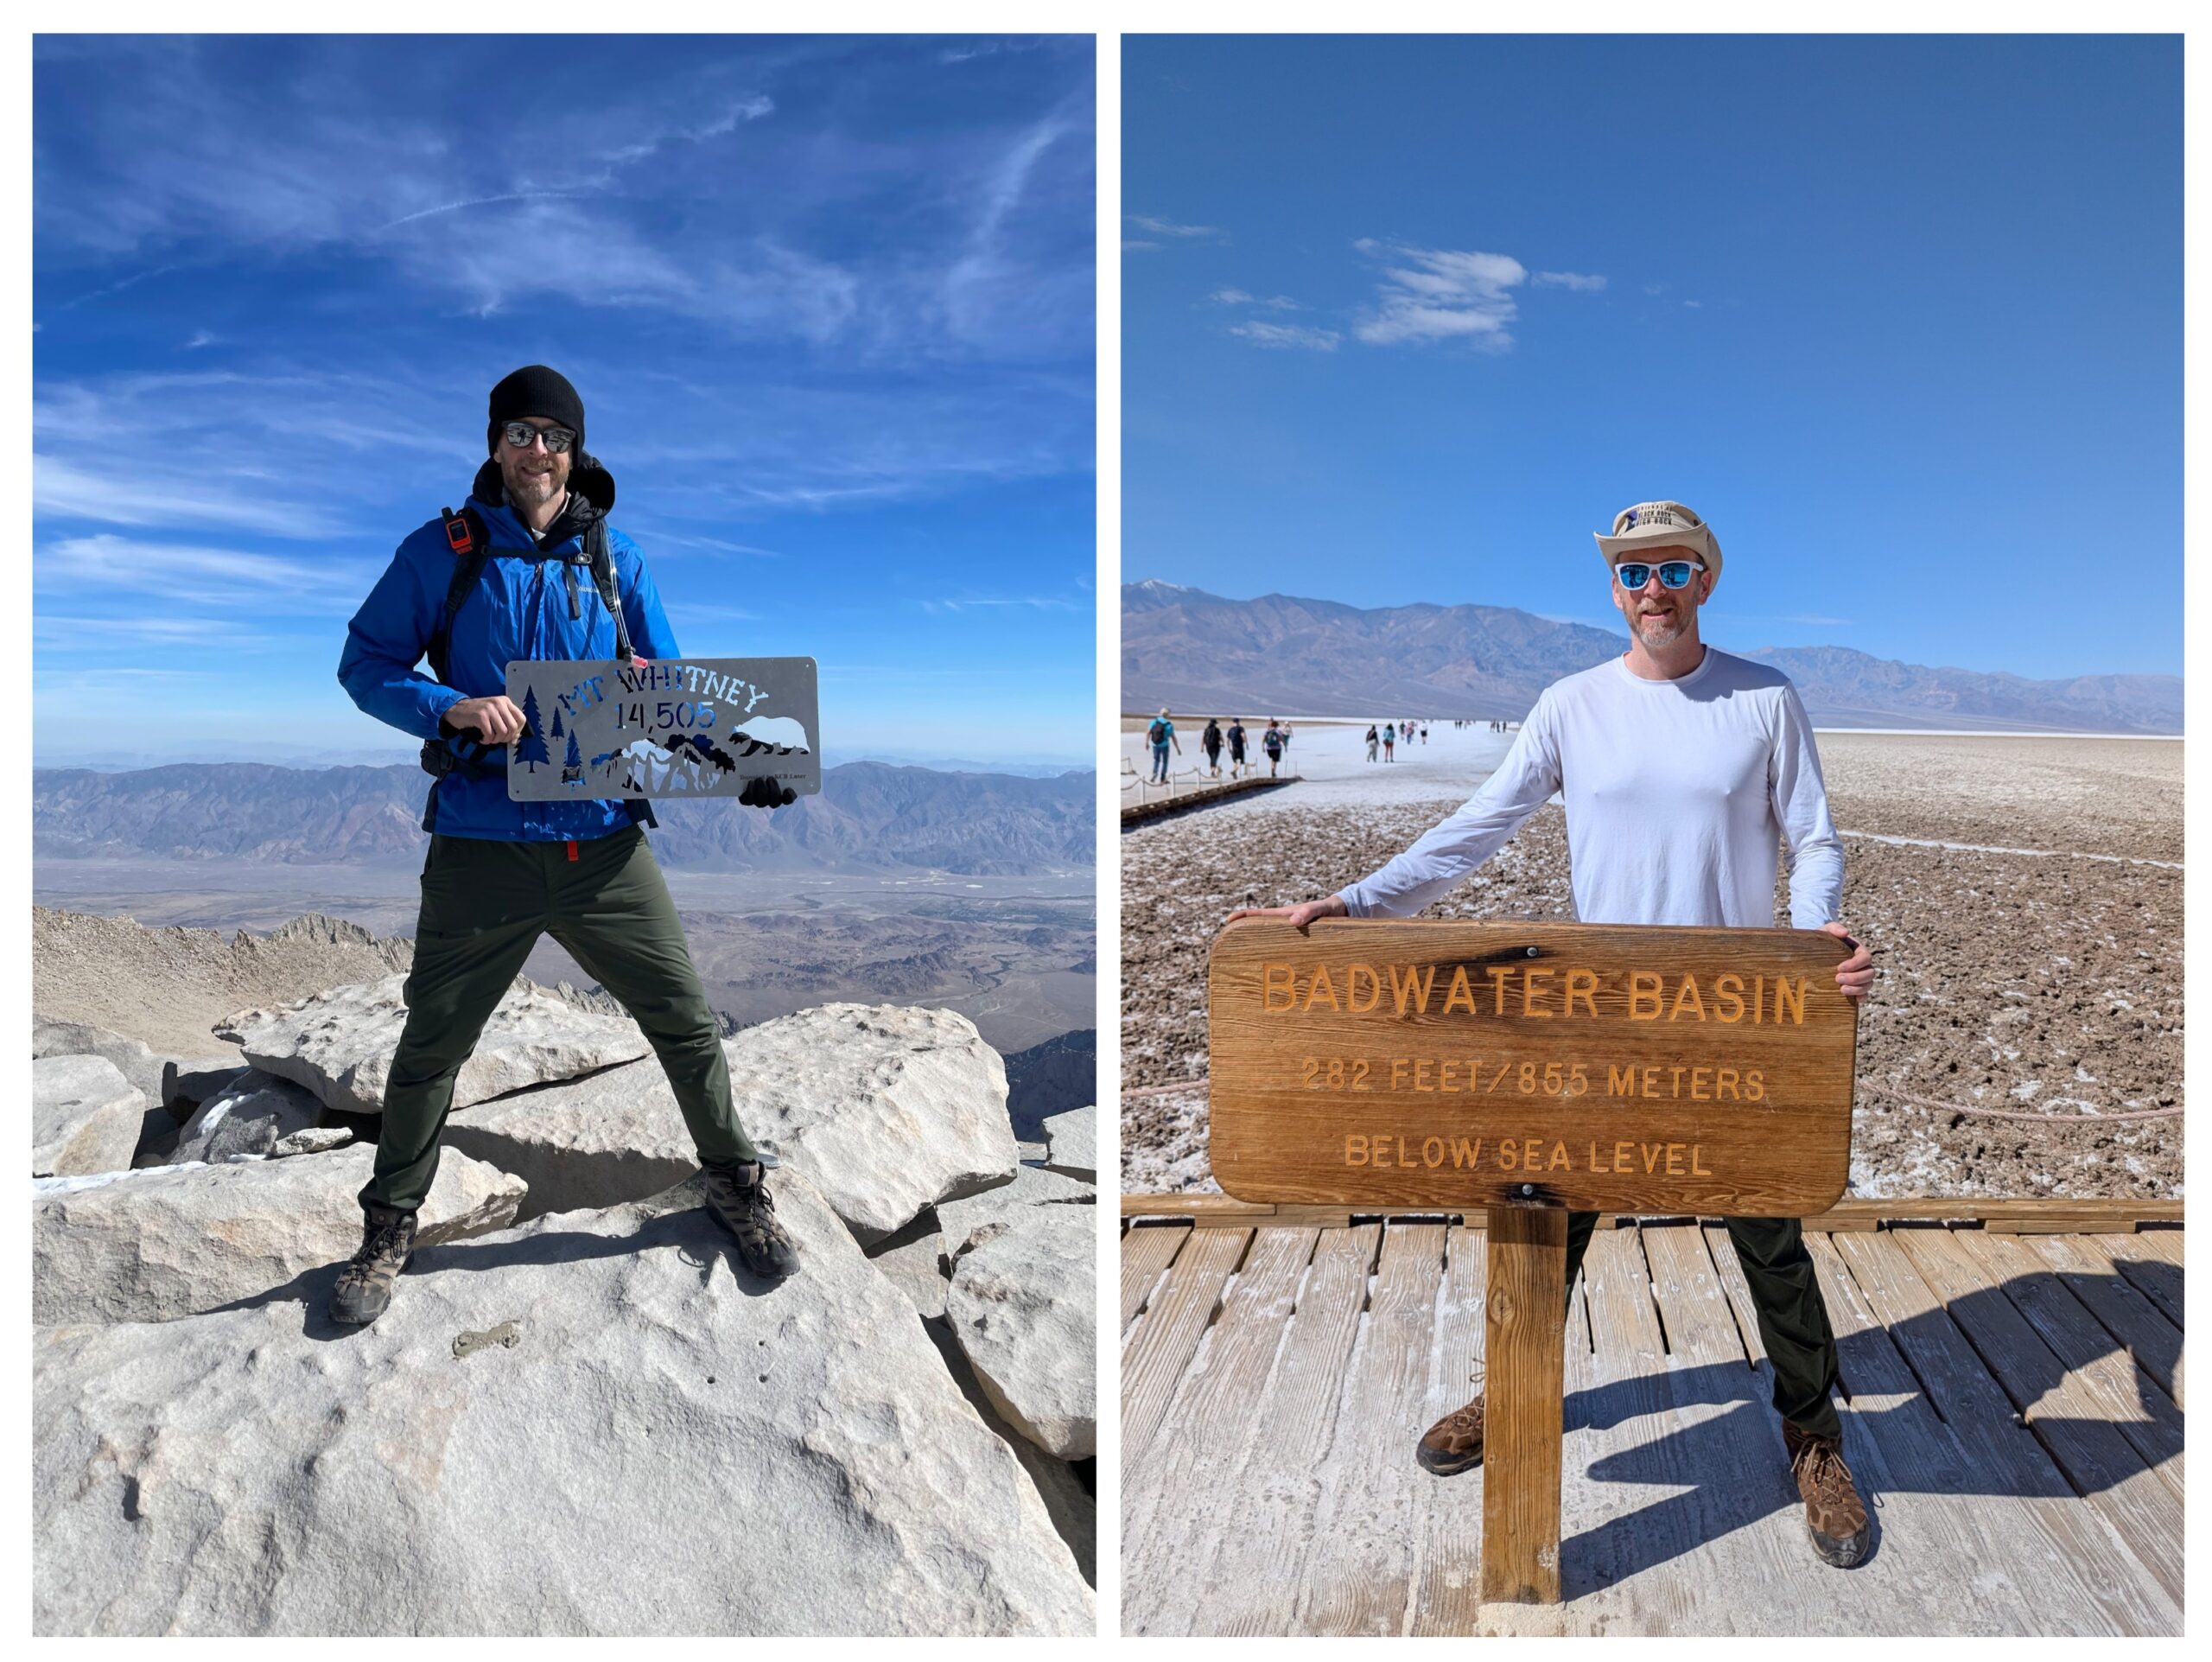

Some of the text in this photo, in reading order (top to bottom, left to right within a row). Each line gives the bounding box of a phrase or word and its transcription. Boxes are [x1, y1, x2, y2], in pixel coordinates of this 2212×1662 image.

[613, 665, 769, 713] WHITNEY
[614, 702, 717, 735] 14,505
[1262, 963, 1805, 1025] BADWATER BASIN
[1301, 1057, 1370, 1091] 282
[1607, 1064, 1764, 1101] METERS
[1344, 1134, 1713, 1176] BELOW SEA LEVEL
